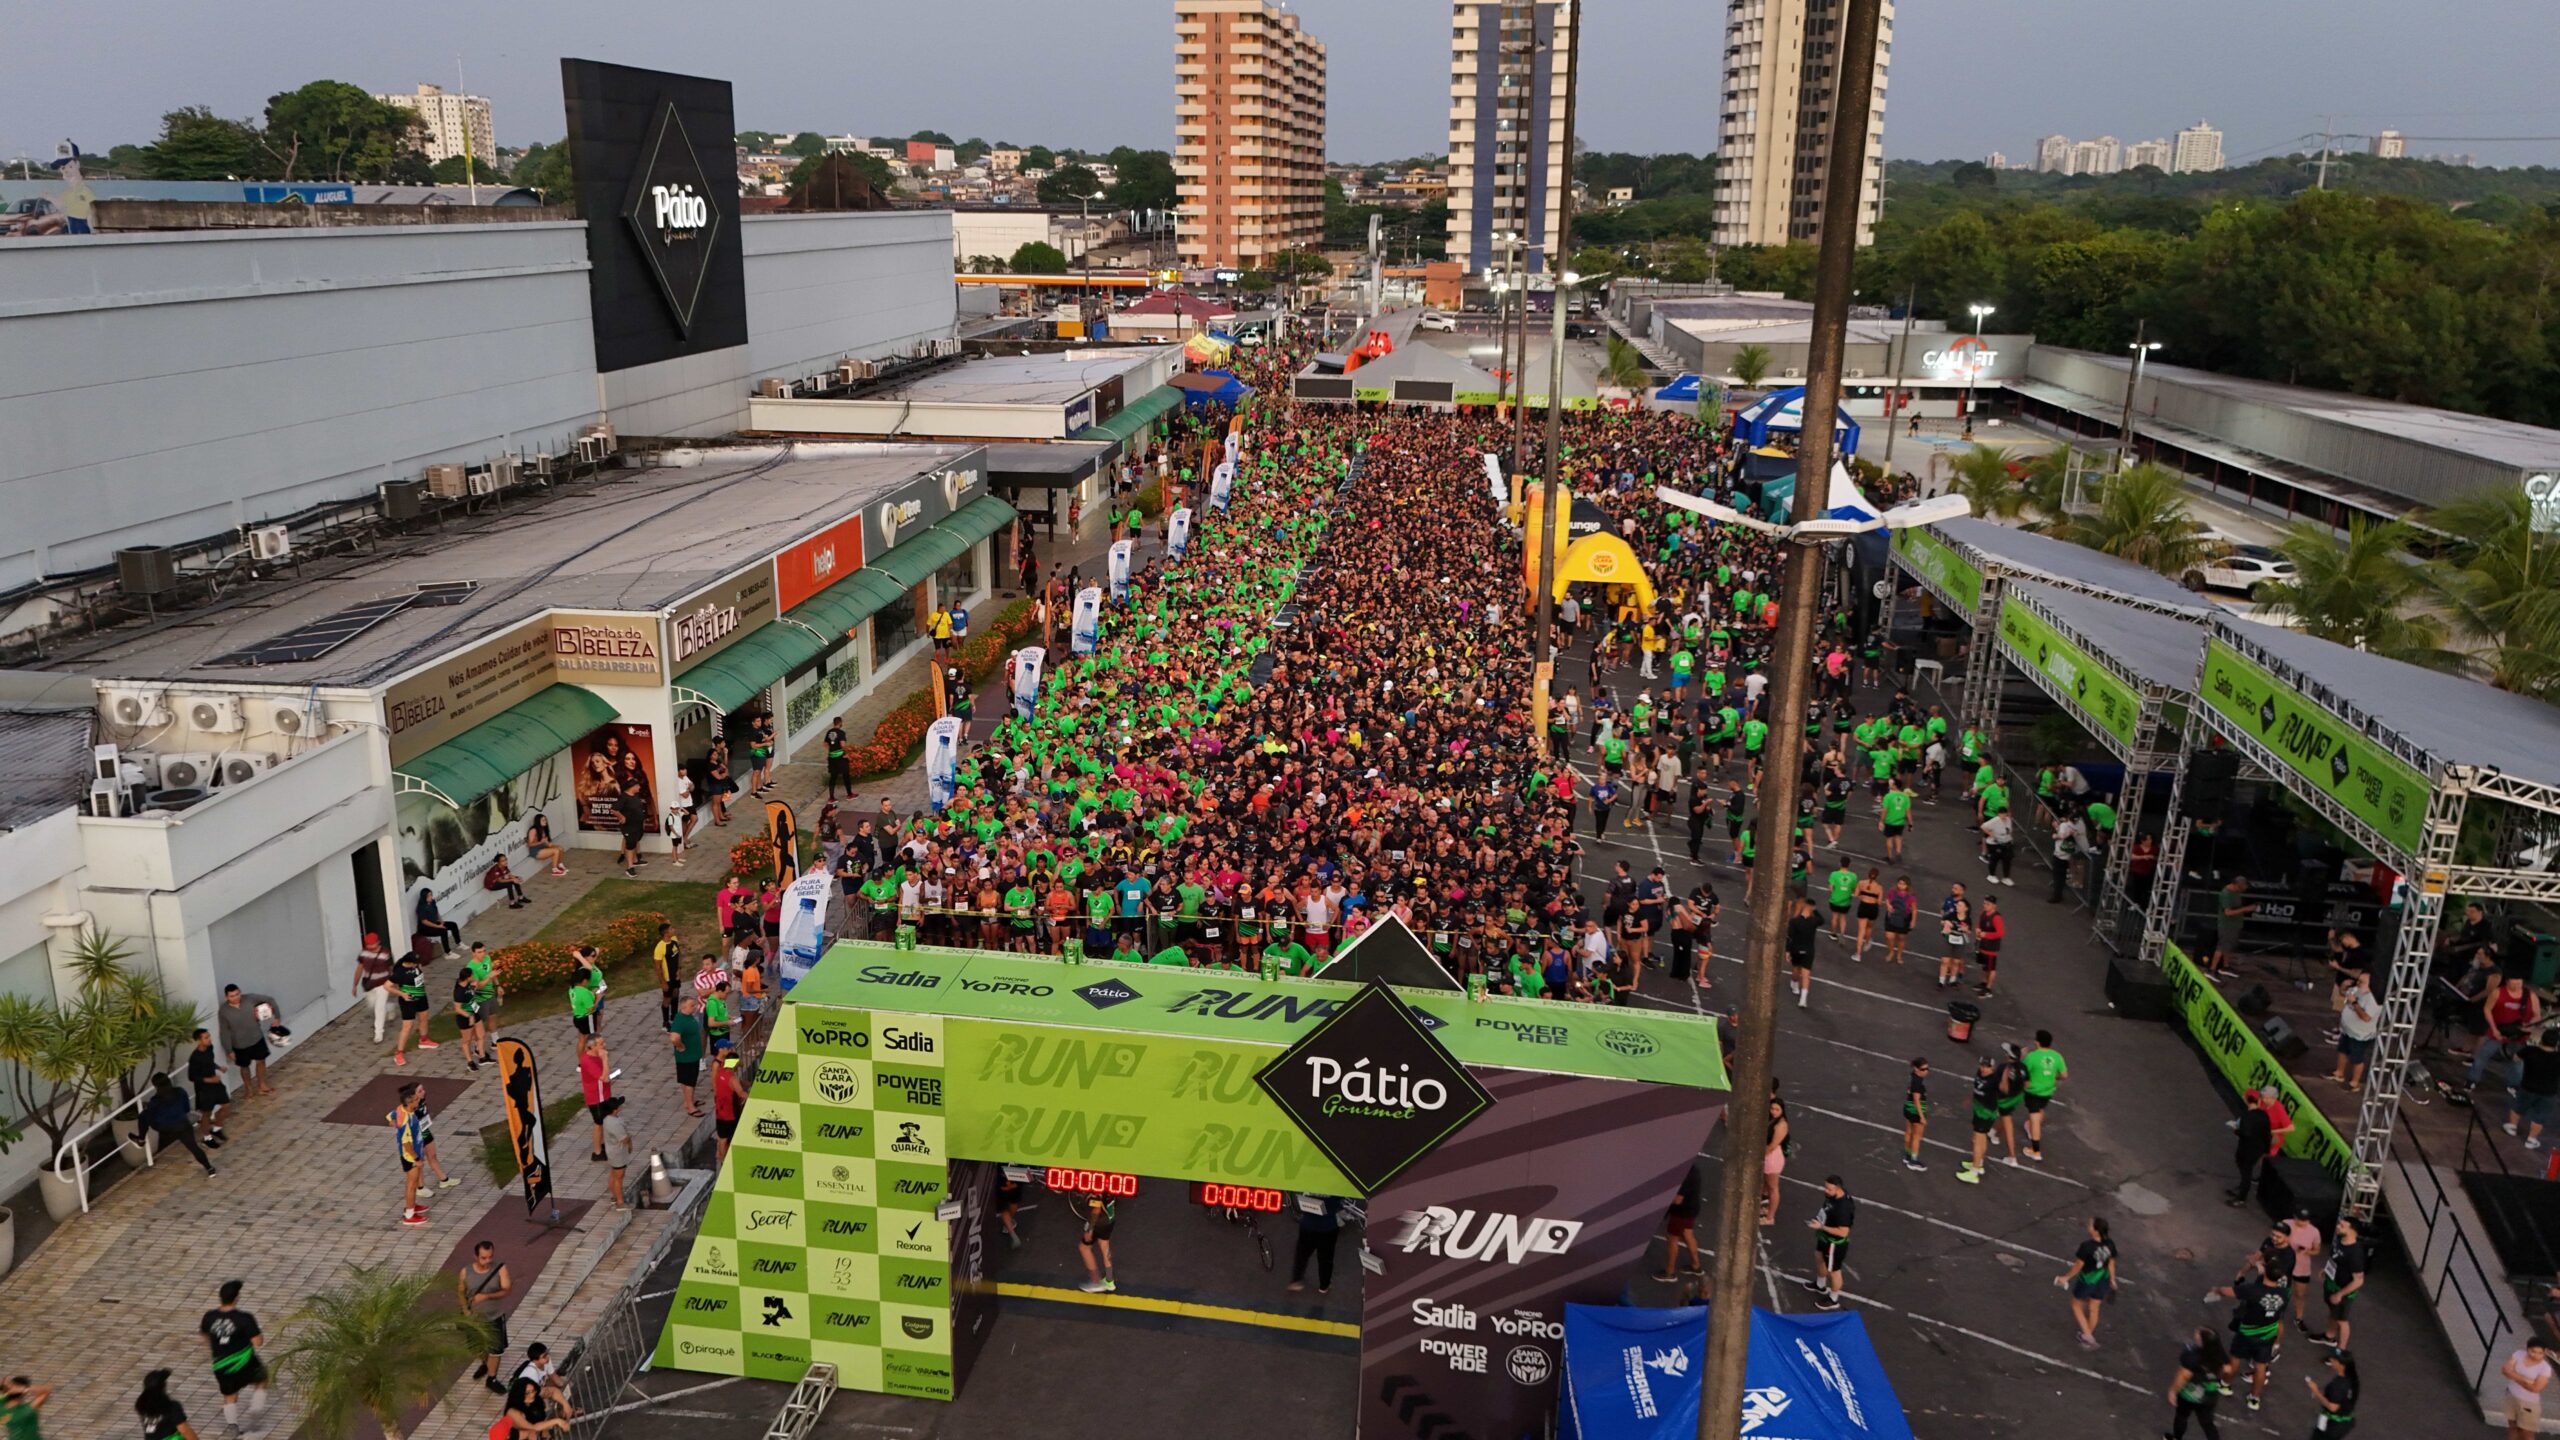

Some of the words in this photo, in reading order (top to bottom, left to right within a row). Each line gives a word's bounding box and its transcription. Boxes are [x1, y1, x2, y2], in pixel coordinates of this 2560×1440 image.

[314, 190, 348, 204] ALUGUEL
[652, 183, 707, 228] Pátio
[813, 543, 837, 577] help!
[582, 626, 623, 639] Portas
[625, 627, 642, 639] da
[583, 638, 656, 659] BELEZA
[448, 671, 465, 689] Nós
[466, 657, 498, 680] Amamos
[498, 646, 522, 664] Cuidar
[406, 695, 446, 729] BELEZA
[856, 965, 942, 991] Sadia
[960, 977, 1055, 998] YoPRO
[1087, 986, 1131, 1000] Pátio
[1475, 1017, 1569, 1038] POWER
[1609, 1028, 1648, 1040] SANTA
[801, 1028, 869, 1048] YoPRO
[882, 1027, 934, 1053] Sadia
[1517, 1031, 1569, 1047] ADE
[1604, 1034, 1653, 1046] CLARA
[819, 1072, 853, 1084] CLARA
[822, 1066, 850, 1076] SANTA
[877, 1073, 942, 1092] POWER
[1305, 1056, 1447, 1111] Pátio
[907, 1090, 942, 1106] ADE
[1322, 1094, 1416, 1121] Gourmet
[760, 1121, 787, 1131] STELLA
[760, 1128, 788, 1137] ARTOIS
[891, 1142, 931, 1156] QUAKER
[816, 1180, 867, 1193] ESSENTIAL
[1047, 1167, 1137, 1195] 00:00:00
[1204, 1184, 1282, 1211] 0:00:00
[745, 1209, 798, 1231] Secret
[896, 1239, 932, 1253] Rexona
[693, 1266, 710, 1275] Tia
[710, 1267, 738, 1278] Sônia
[1412, 1297, 1477, 1331] Sadia
[1514, 1308, 1544, 1319] DANONE
[1490, 1315, 1565, 1340] YoPRO
[695, 1345, 736, 1358] piraquê
[1420, 1338, 1488, 1360] POWER
[1516, 1349, 1544, 1359] SANTA
[751, 1351, 776, 1360] BLACK
[783, 1354, 807, 1364] SKULL
[1449, 1356, 1488, 1374] ADE
[1512, 1355, 1547, 1367] CLARA
[925, 1386, 950, 1395] CIMED
